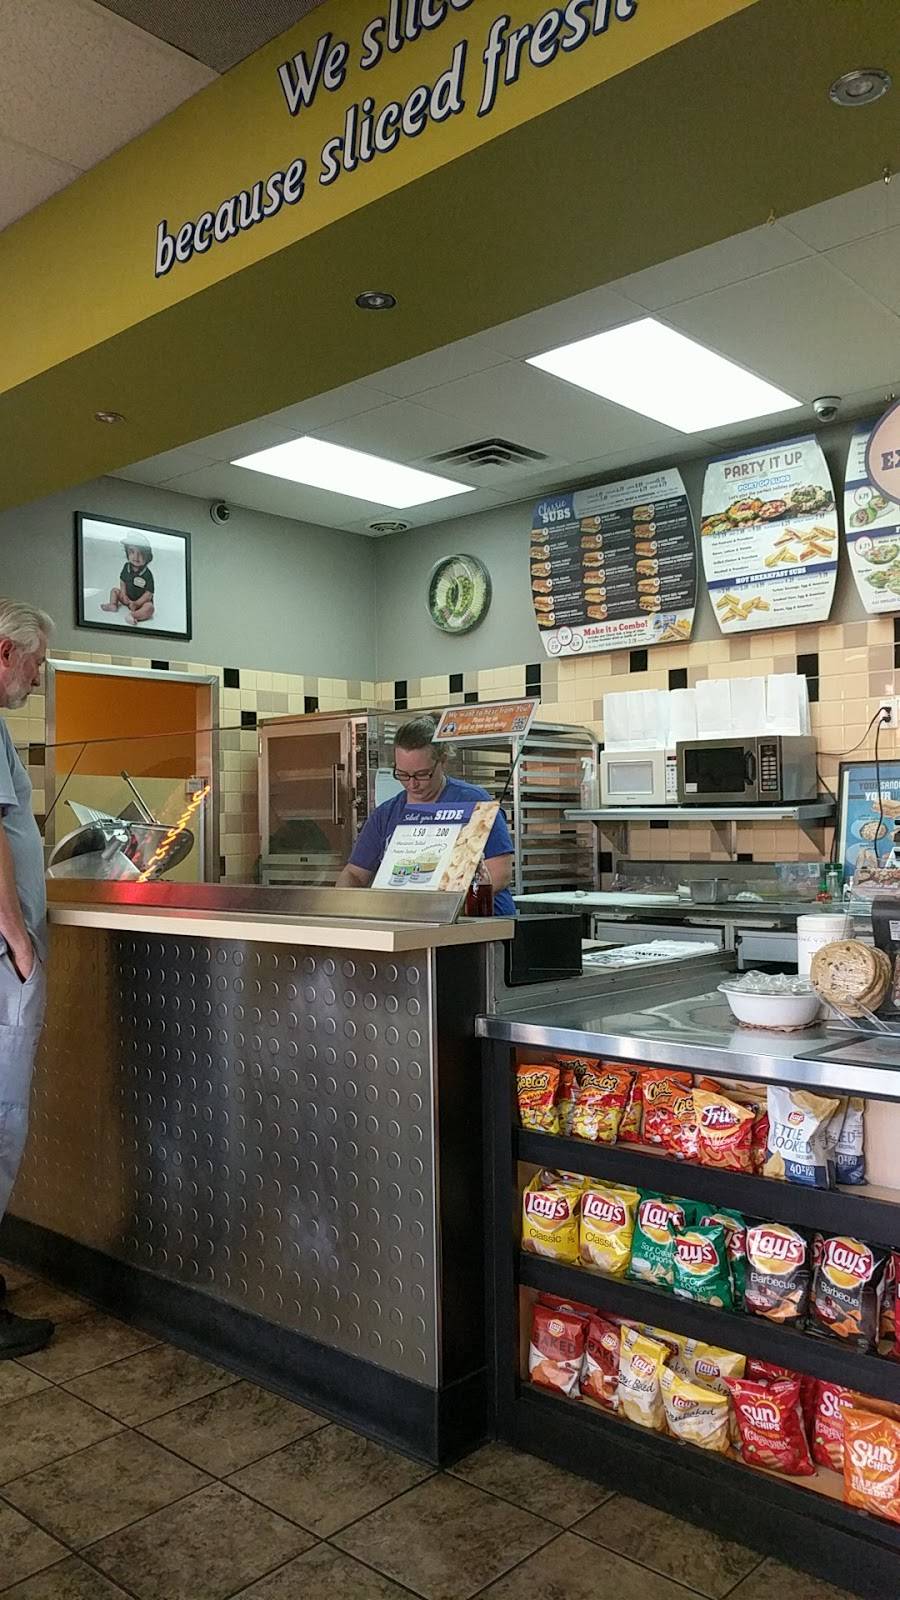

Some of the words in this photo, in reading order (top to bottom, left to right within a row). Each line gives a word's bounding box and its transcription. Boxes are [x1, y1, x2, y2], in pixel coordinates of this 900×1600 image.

[277, 32, 349, 116] We
[360, 0, 473, 70] slic
[154, 158, 306, 277] because
[319, 40, 467, 184] sliced
[724, 460, 765, 479] PARTY
[769, 456, 780, 469] IT
[785, 451, 802, 466] UP
[538, 500, 566, 516] Classic
[543, 508, 571, 523] SUBS
[736, 576, 749, 584] HOT
[750, 570, 787, 582] BREAKFAST
[789, 567, 806, 576] SUBS
[583, 627, 604, 637] Make
[618, 620, 648, 631] Combo!
[434, 809, 464, 821] SIDE
[413, 828, 426, 837] 1.50
[436, 828, 449, 837] 2.00
[517, 1074, 548, 1090] eetos
[774, 1122, 803, 1140] ETTLE
[773, 1136, 812, 1154] OOKED
[529, 1228, 561, 1243] Classic
[585, 1231, 618, 1249] Classic
[641, 1241, 655, 1252] Sour
[674, 1244, 713, 1264] ay's
[751, 1272, 796, 1290] Barbecue
[821, 1281, 860, 1307] Barbecue
[741, 1404, 780, 1426] Sun
[756, 1421, 780, 1431] CHIPS
[851, 1440, 896, 1468] Sun
[867, 1459, 893, 1472] CHIPS
